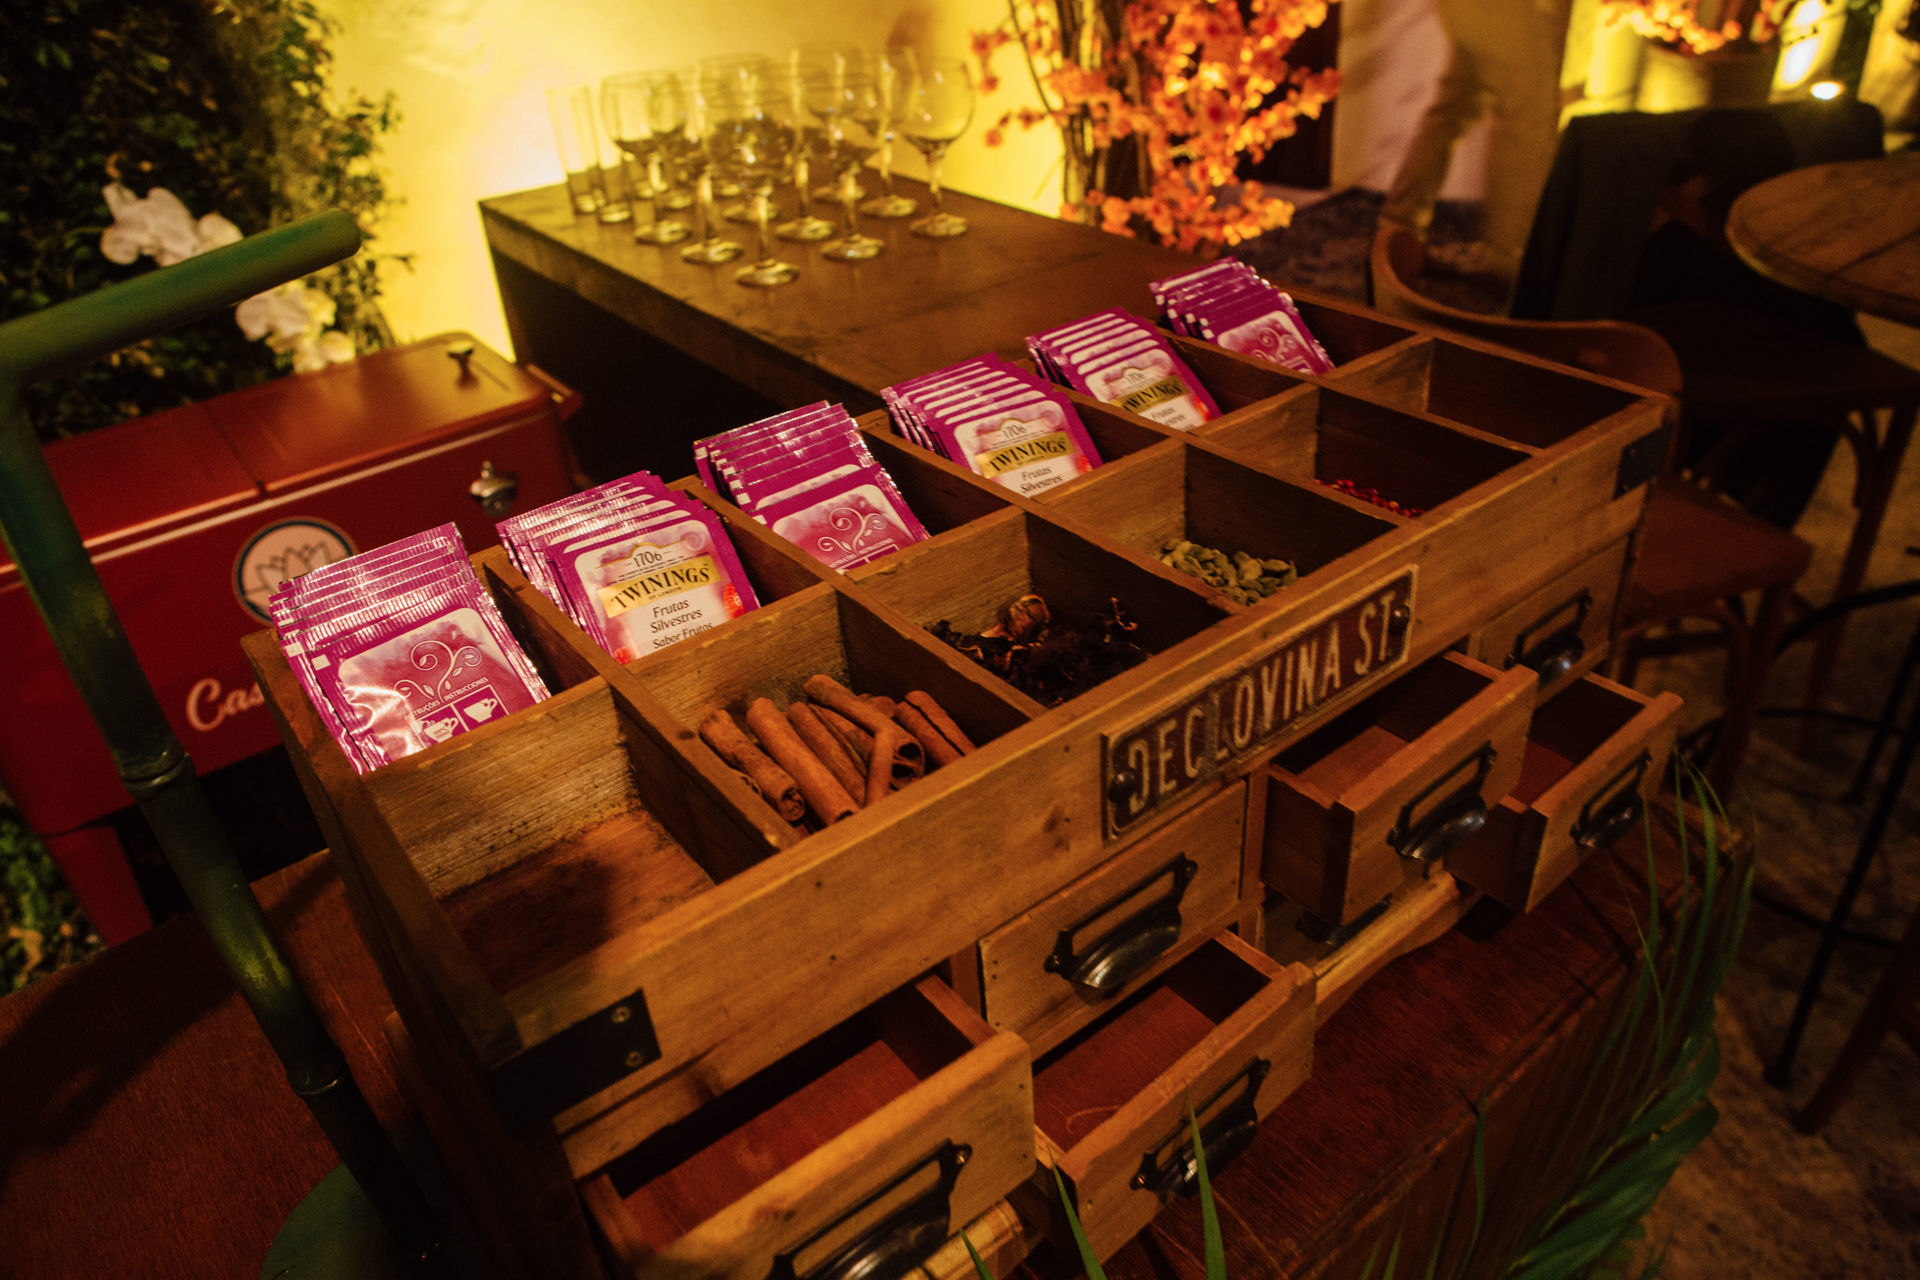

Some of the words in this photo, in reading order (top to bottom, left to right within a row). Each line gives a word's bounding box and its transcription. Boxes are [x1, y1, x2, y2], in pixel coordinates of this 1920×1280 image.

[988, 440, 1068, 472] TWININGS
[633, 551, 663, 568] 1706
[610, 567, 710, 609] TWININGS
[652, 600, 690, 618] Frutas
[650, 610, 703, 633] Silvestres
[652, 634, 681, 649] Sabor
[443, 676, 489, 701] INSTRUCCIONES
